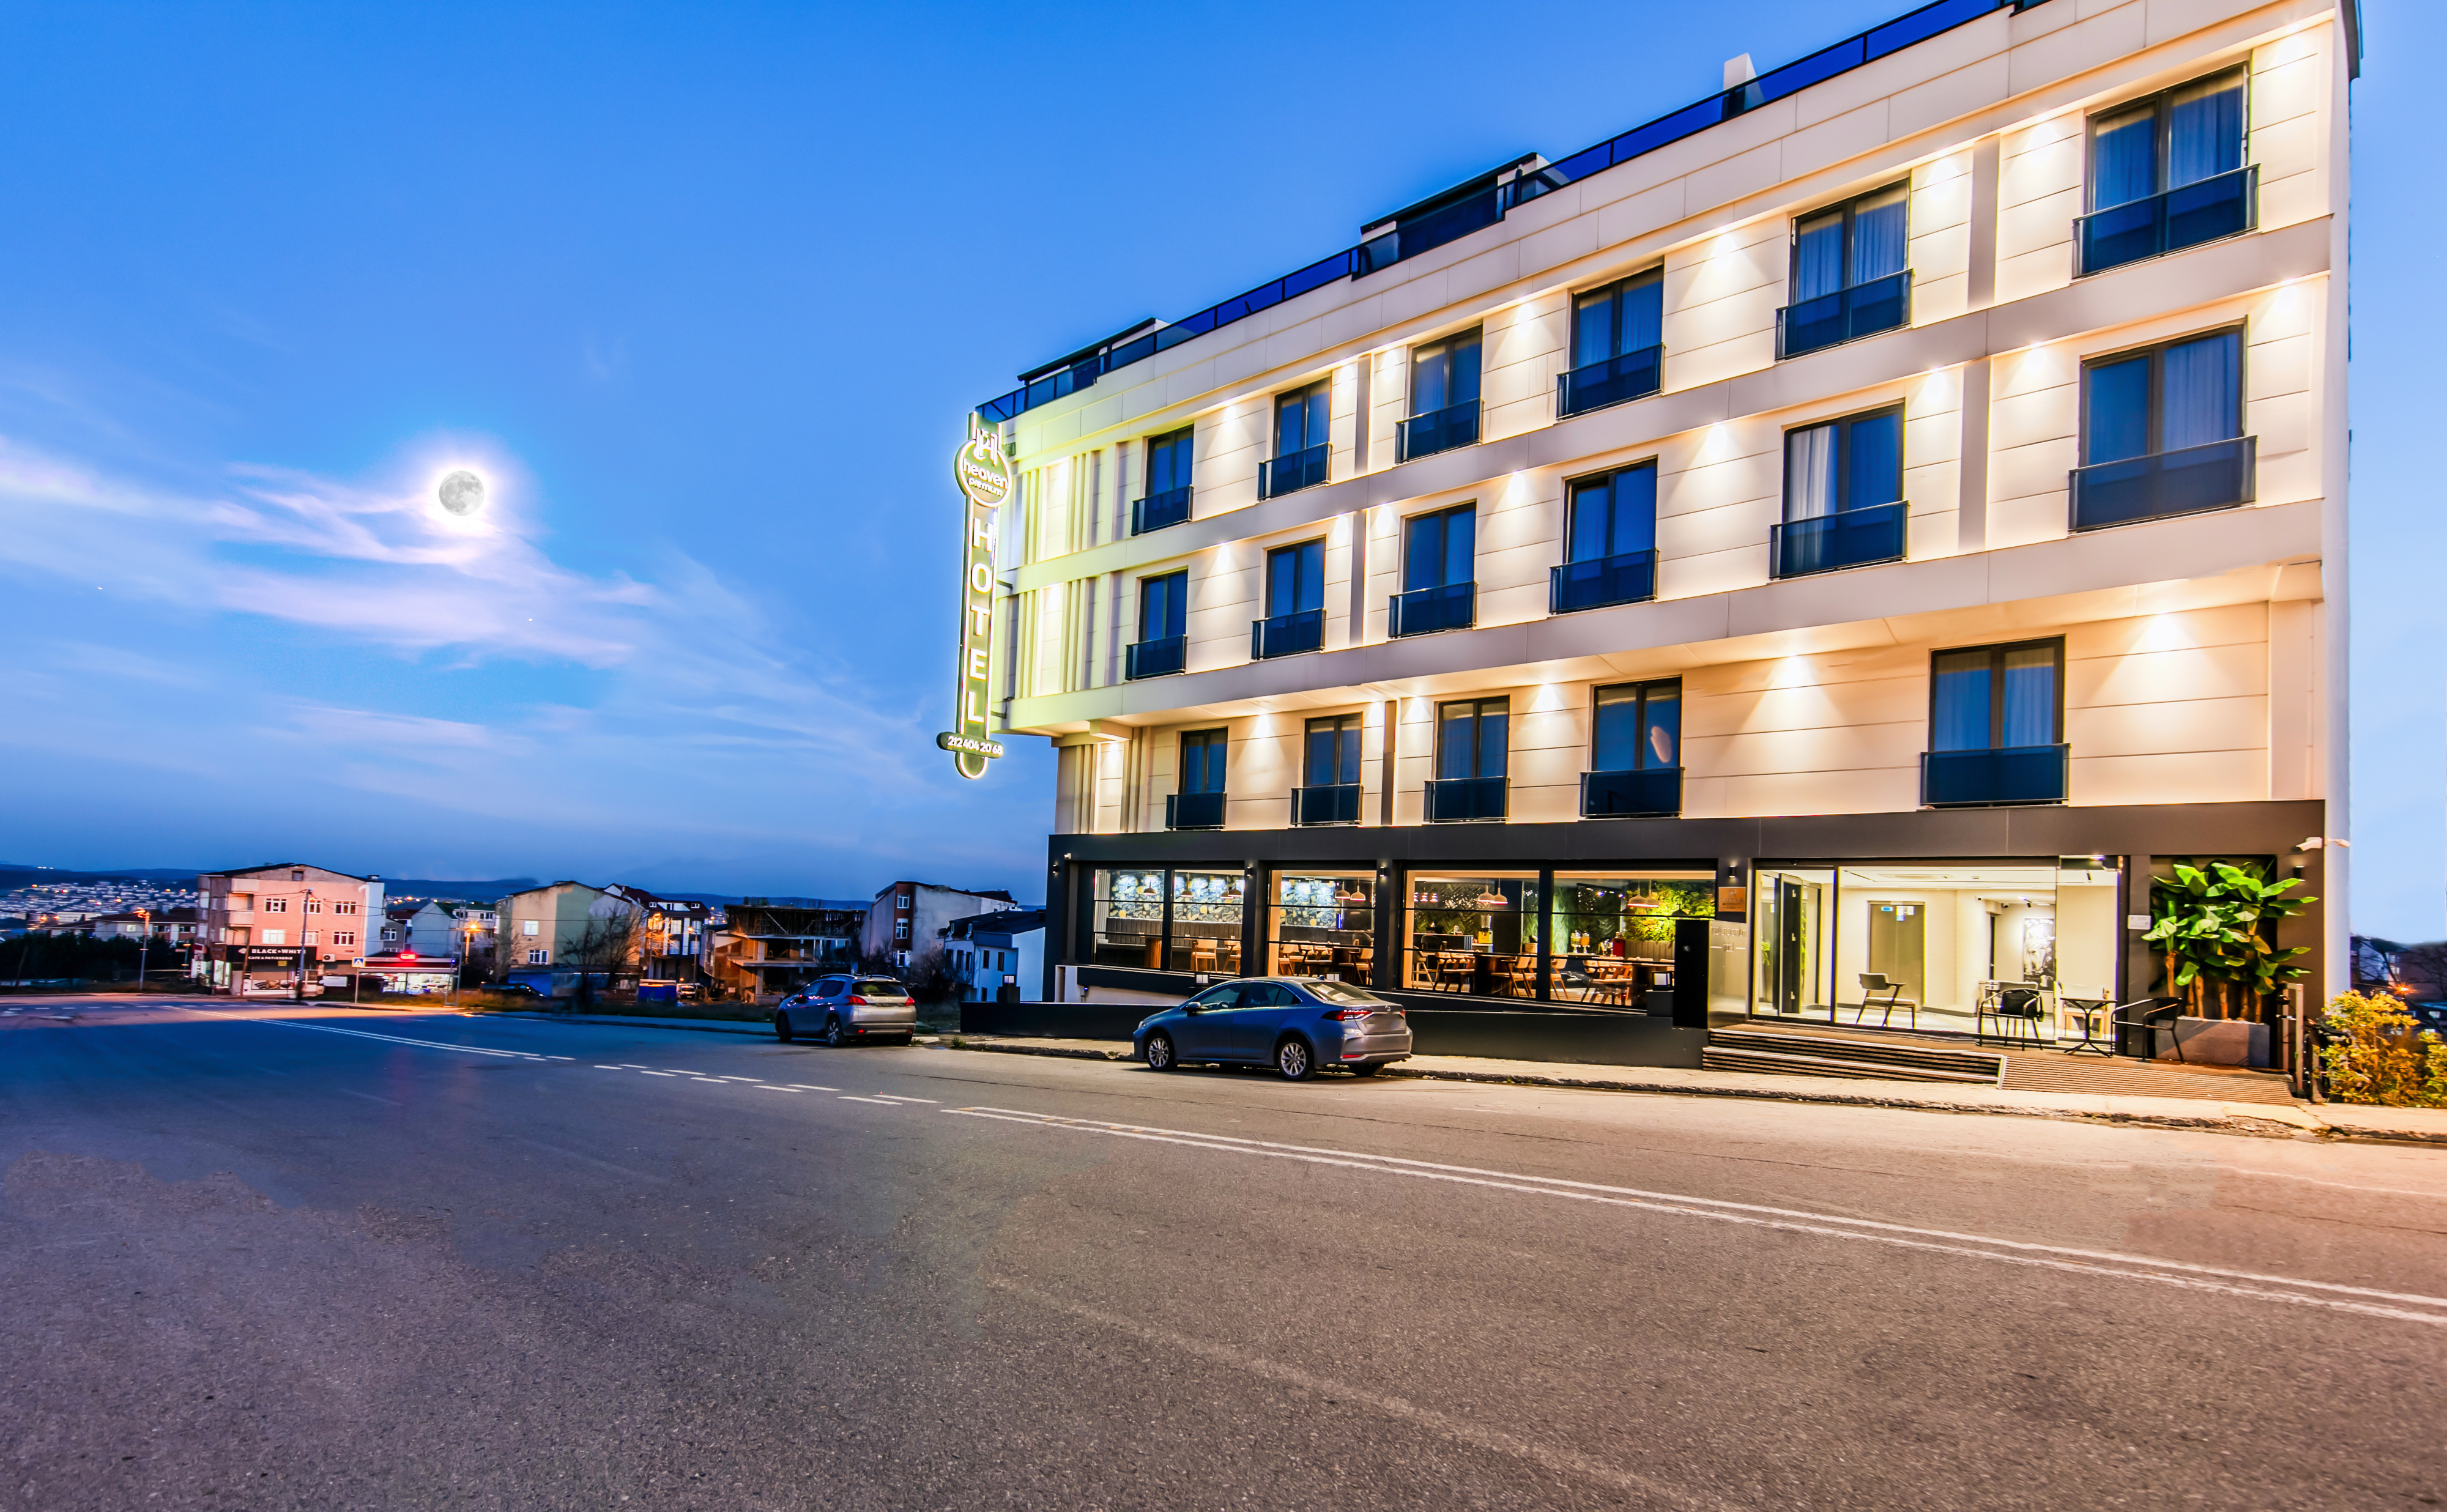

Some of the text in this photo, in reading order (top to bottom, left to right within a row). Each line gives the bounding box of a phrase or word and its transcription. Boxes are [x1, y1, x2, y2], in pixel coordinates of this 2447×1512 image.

[963, 458, 1008, 489] heaven
[968, 476, 1003, 497] premium
[967, 517, 993, 723] HOTEL
[948, 735, 1003, 755] 212 404 20 68
